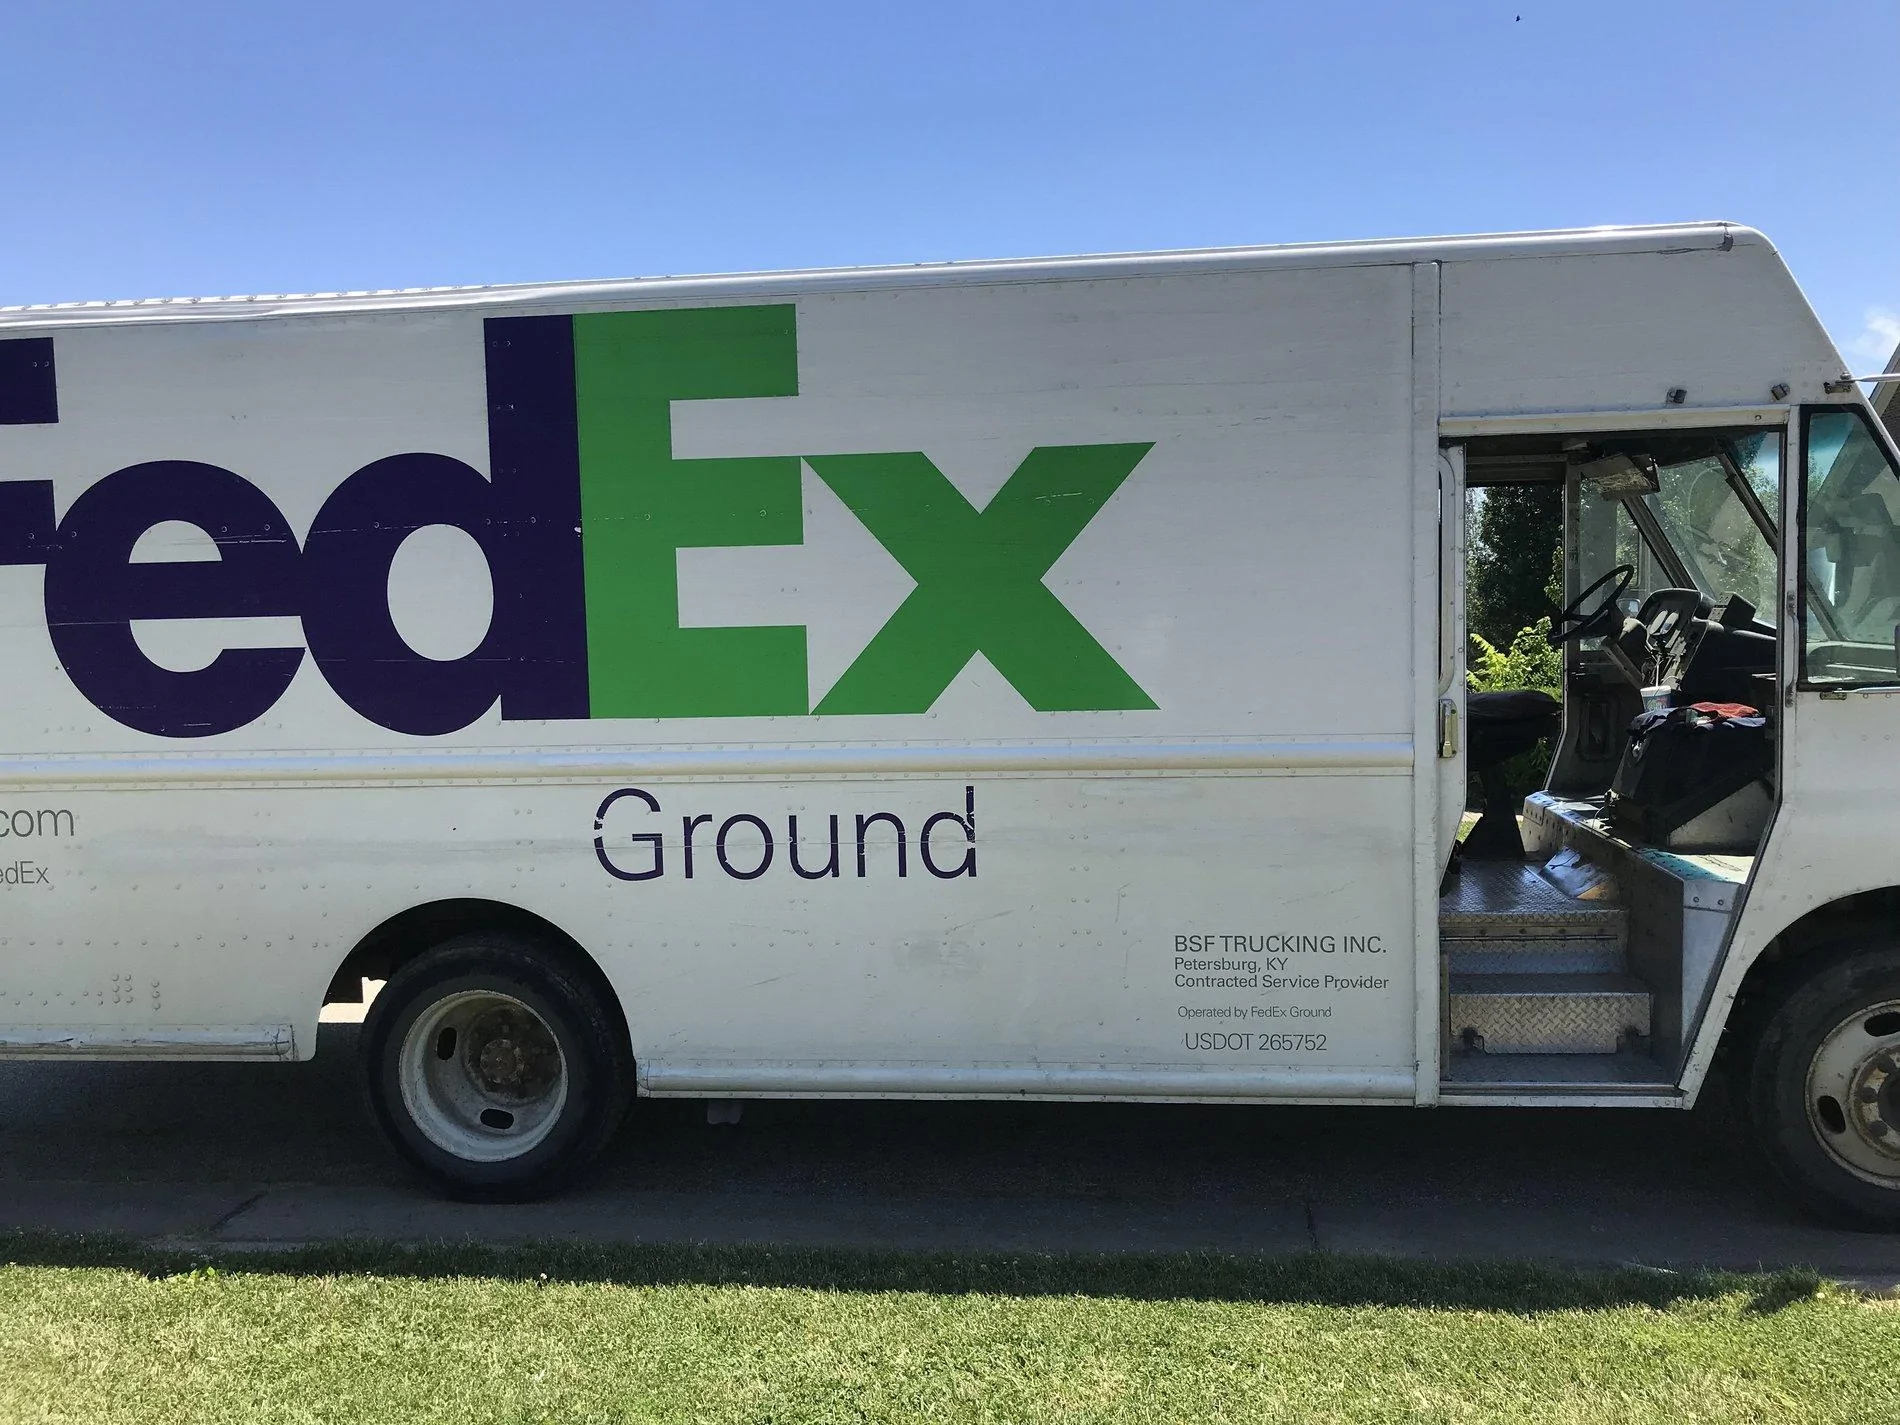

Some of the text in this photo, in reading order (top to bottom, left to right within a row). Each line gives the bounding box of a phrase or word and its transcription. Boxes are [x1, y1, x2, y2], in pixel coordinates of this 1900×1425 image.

[0, 304, 1161, 738] edEx
[593, 785, 977, 881] Ground
[0, 861, 49, 884] dEx
[1175, 935, 1386, 953] BSF TRUCKING INC.
[1175, 957, 1288, 973] Petersburg, KY
[1175, 975, 1389, 989] Contracted Service Provider
[1178, 1006, 1332, 1019] Operated by FedEx Ground
[1185, 1033, 1327, 1050] USDOT 265752
